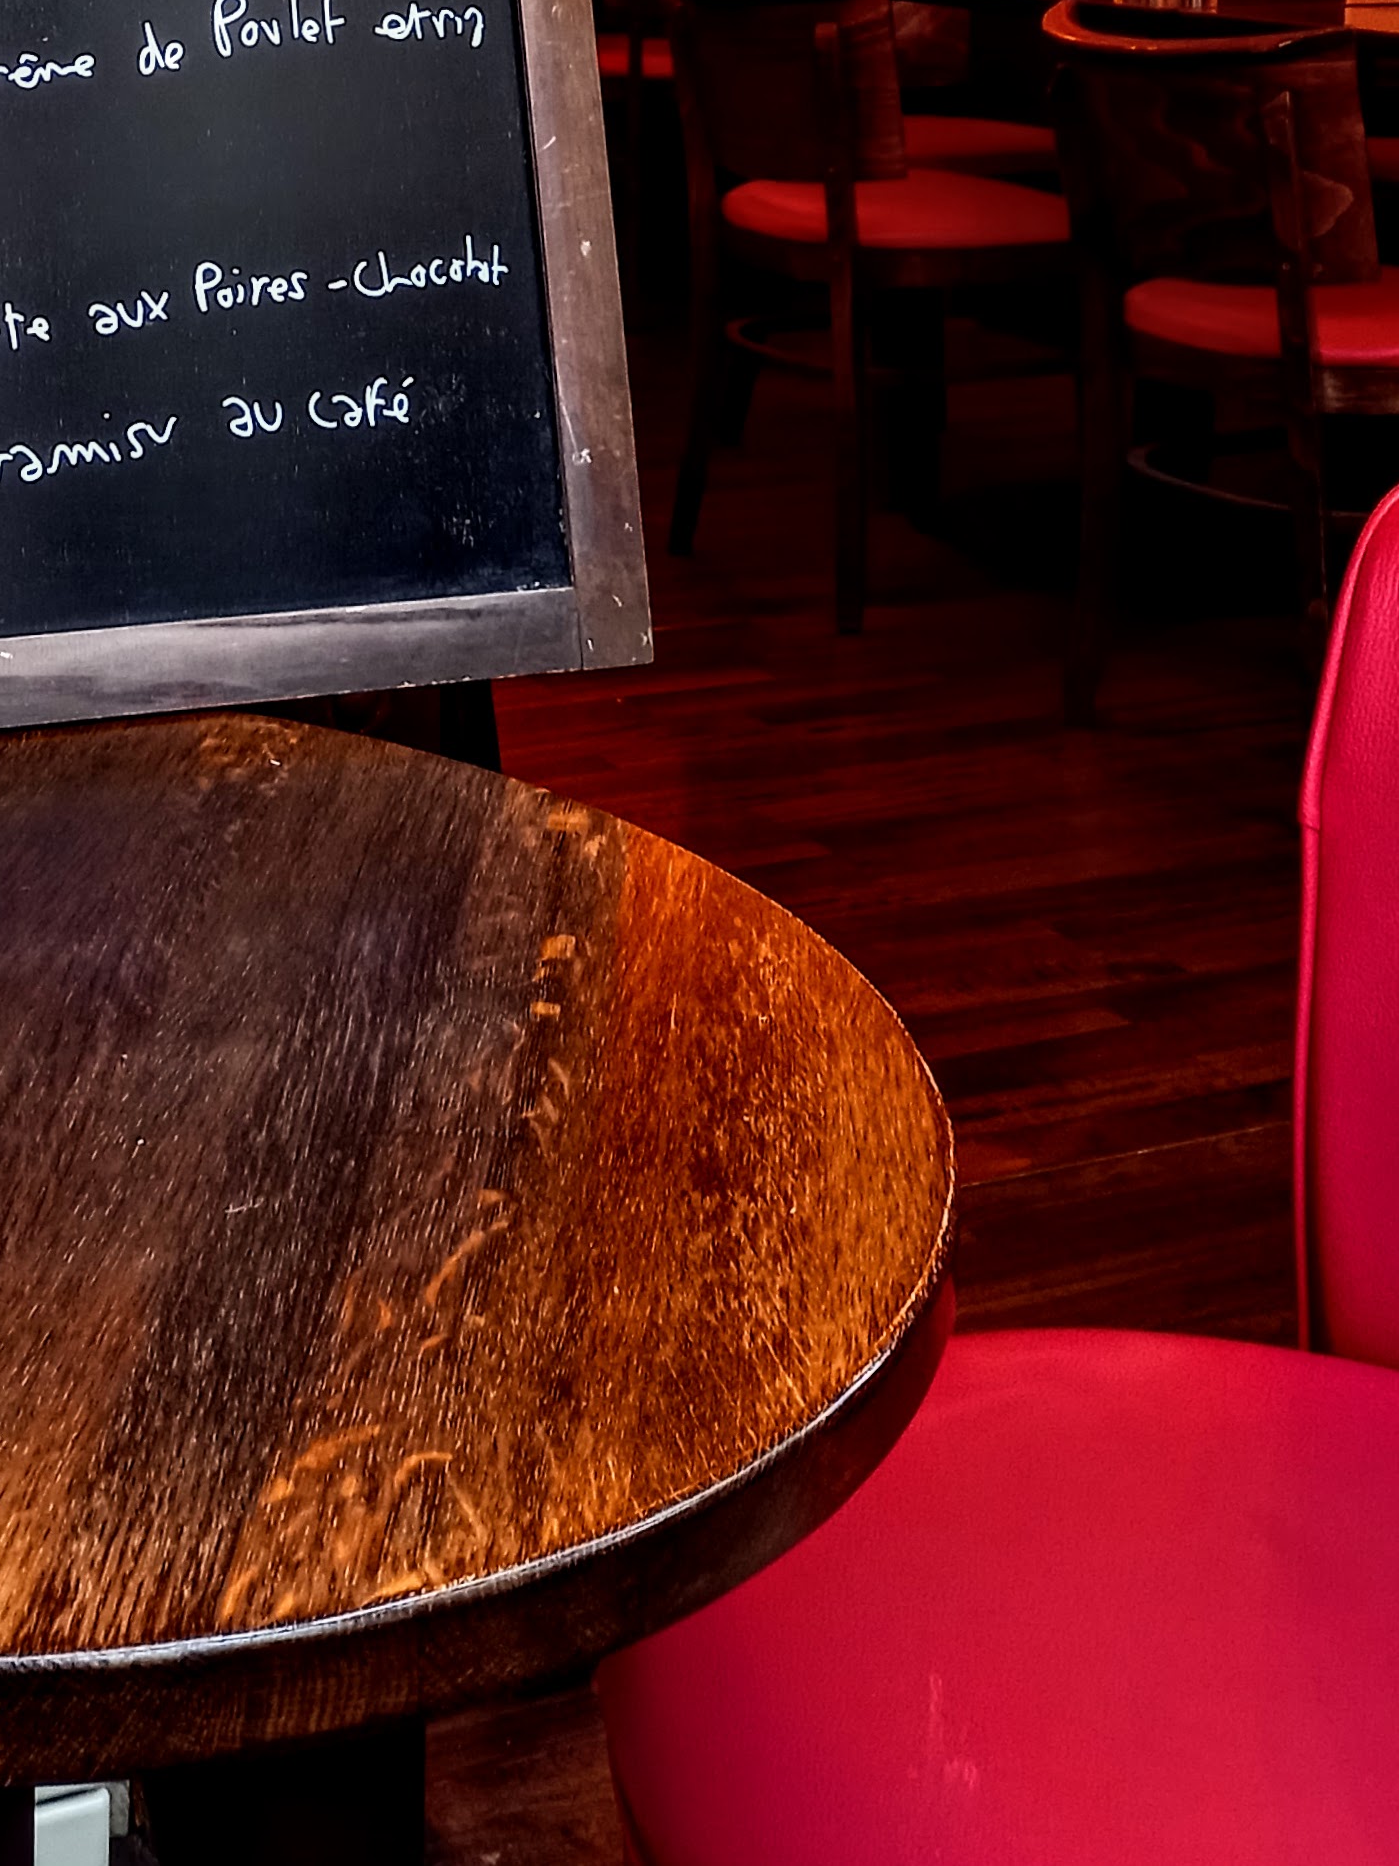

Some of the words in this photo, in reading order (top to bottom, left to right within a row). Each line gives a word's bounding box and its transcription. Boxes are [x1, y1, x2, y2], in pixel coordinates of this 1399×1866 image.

[138, 21, 185, 75] de
[88, 290, 170, 335] aux
[195, 261, 309, 312] Poires
[222, 396, 284, 438] au
